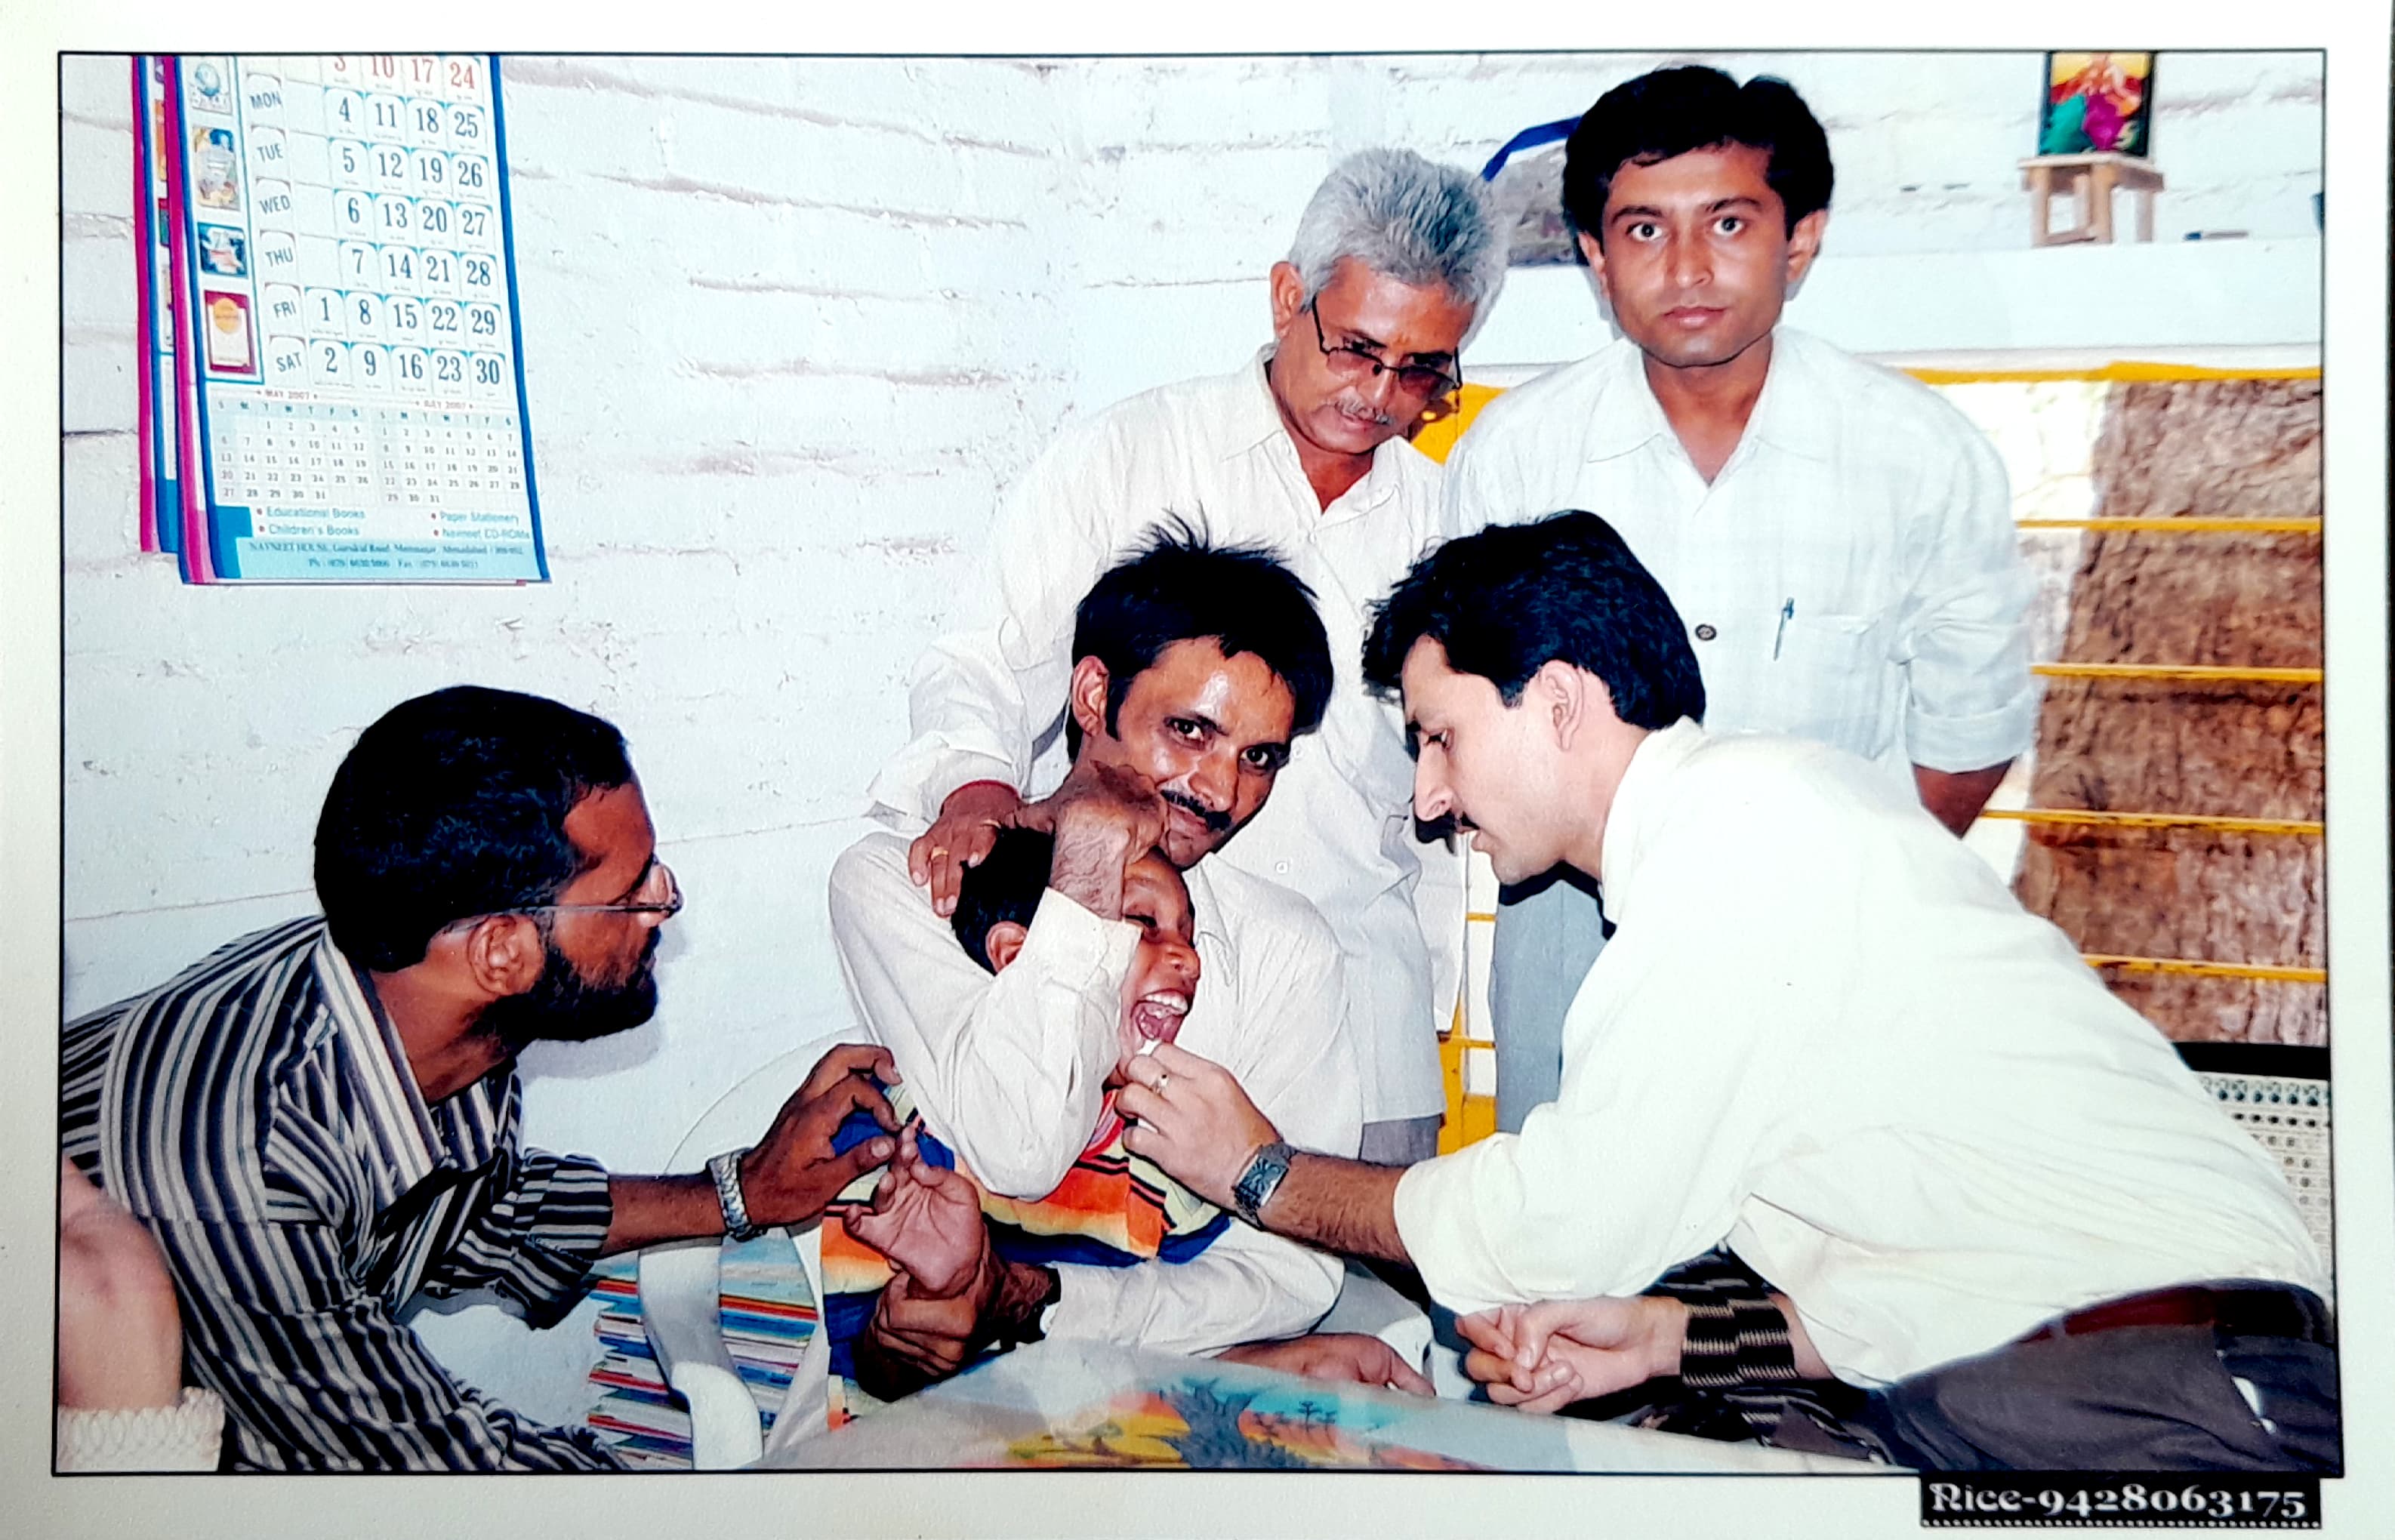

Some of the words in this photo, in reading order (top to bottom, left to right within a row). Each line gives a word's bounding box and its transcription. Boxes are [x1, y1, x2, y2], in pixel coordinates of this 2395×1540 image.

[372, 56, 394, 78] 10
[411, 58, 433, 83] 17
[450, 62, 475, 89] 24
[250, 91, 282, 109] MON
[339, 97, 351, 122] 4
[375, 103, 397, 128] 11
[417, 107, 439, 133] 18
[454, 112, 478, 138] 25
[257, 143, 283, 162] TUE
[343, 148, 355, 173] 5
[378, 152, 403, 178] 12
[421, 157, 442, 183] 19
[459, 162, 482, 187] 26
[259, 195, 291, 214] WED
[348, 197, 359, 223] 6
[384, 202, 408, 228] 13
[423, 205, 447, 233] 20
[462, 210, 485, 236] 27
[265, 247, 293, 267] THU
[352, 248, 363, 274] 7
[388, 254, 412, 279] 14
[427, 256, 450, 282] 21
[466, 260, 491, 286] 28
[273, 300, 296, 319] FRI
[322, 297, 330, 321] 1
[359, 299, 371, 325] 8
[393, 303, 418, 329] 15
[432, 306, 458, 331] 22
[471, 309, 495, 335] 29
[276, 352, 301, 372] SAT
[325, 347, 338, 373] 2
[365, 350, 376, 376] 9
[399, 353, 423, 379] 16
[437, 356, 461, 382] 23
[476, 359, 499, 384] 30
[265, 390, 283, 398] MAY
[267, 507, 329, 519] Educational
[332, 507, 365, 519] Books
[327, 525, 359, 535] Books
